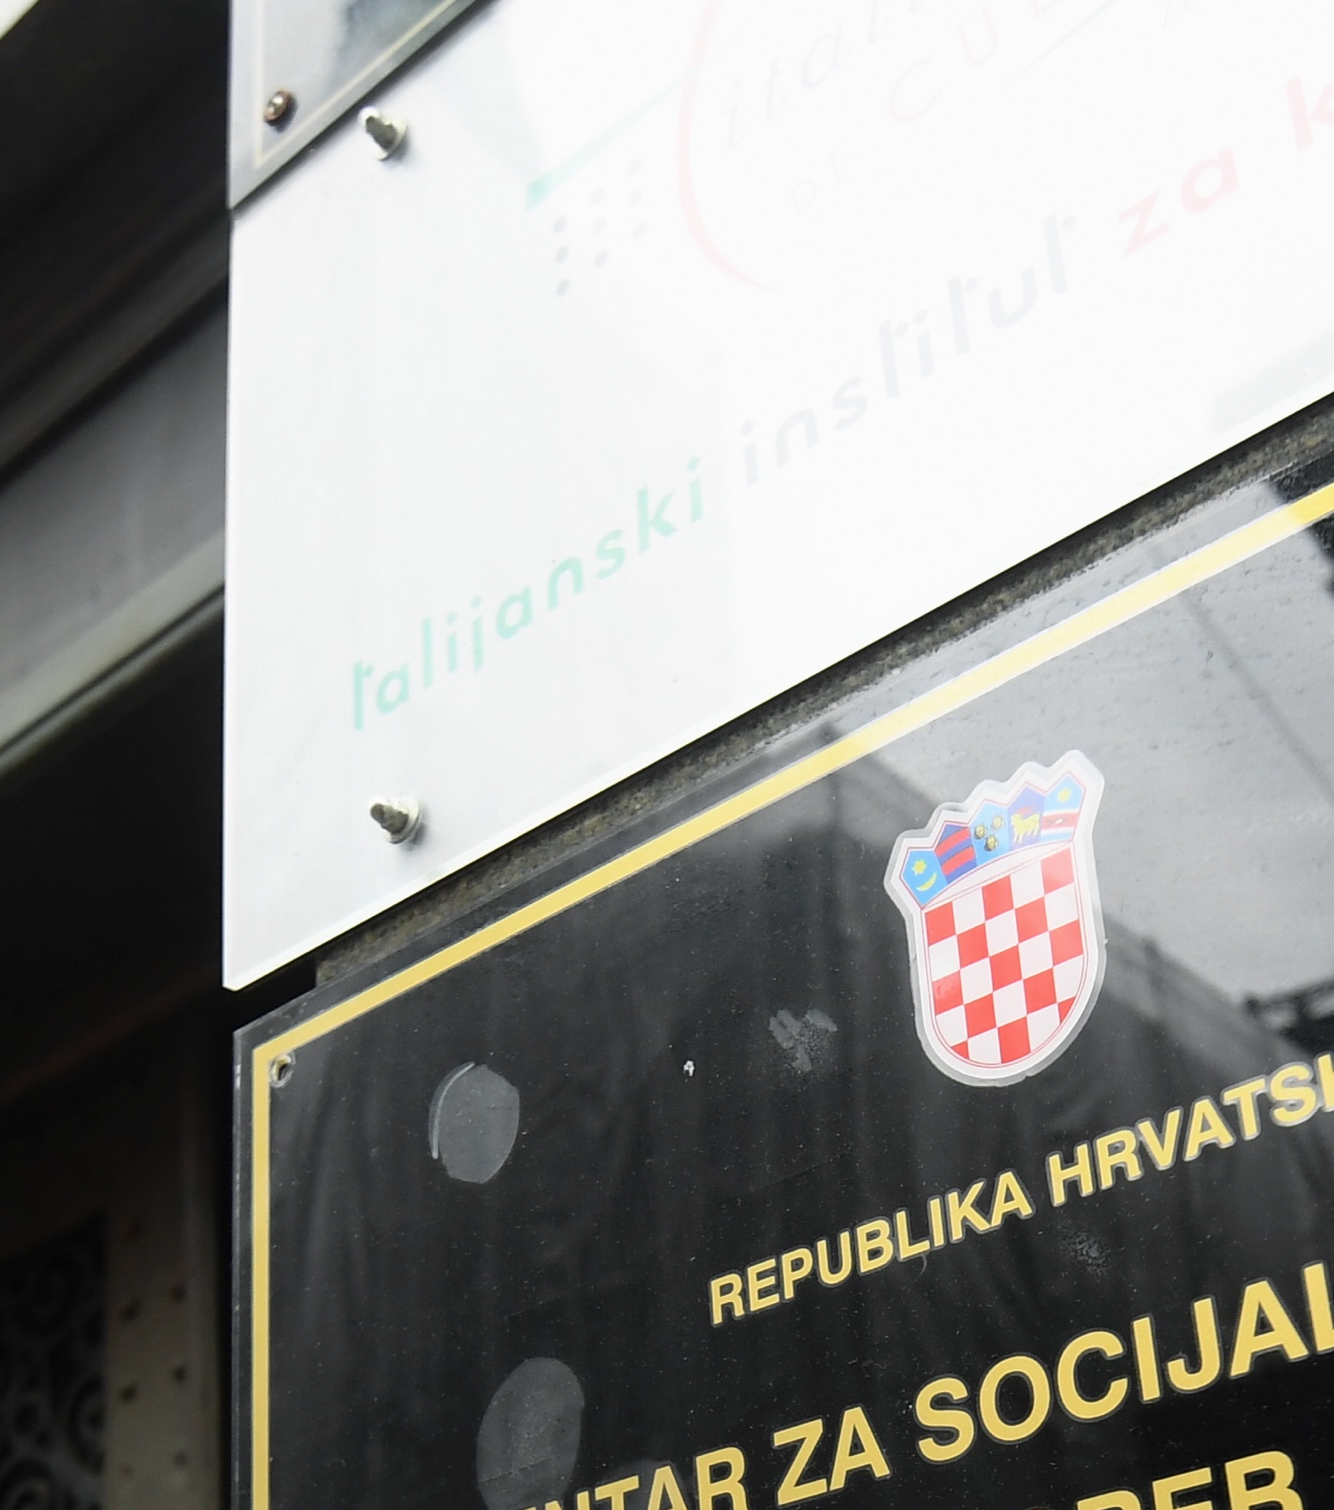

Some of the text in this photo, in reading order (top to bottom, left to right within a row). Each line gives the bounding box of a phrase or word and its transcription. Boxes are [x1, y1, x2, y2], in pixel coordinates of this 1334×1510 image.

[351, 454, 706, 733] talijanski
[739, 211, 1079, 490] institut
[1116, 144, 1242, 259] za
[709, 1171, 1034, 1326] REPUBLIKA
[772, 1405, 892, 1507] ZA
